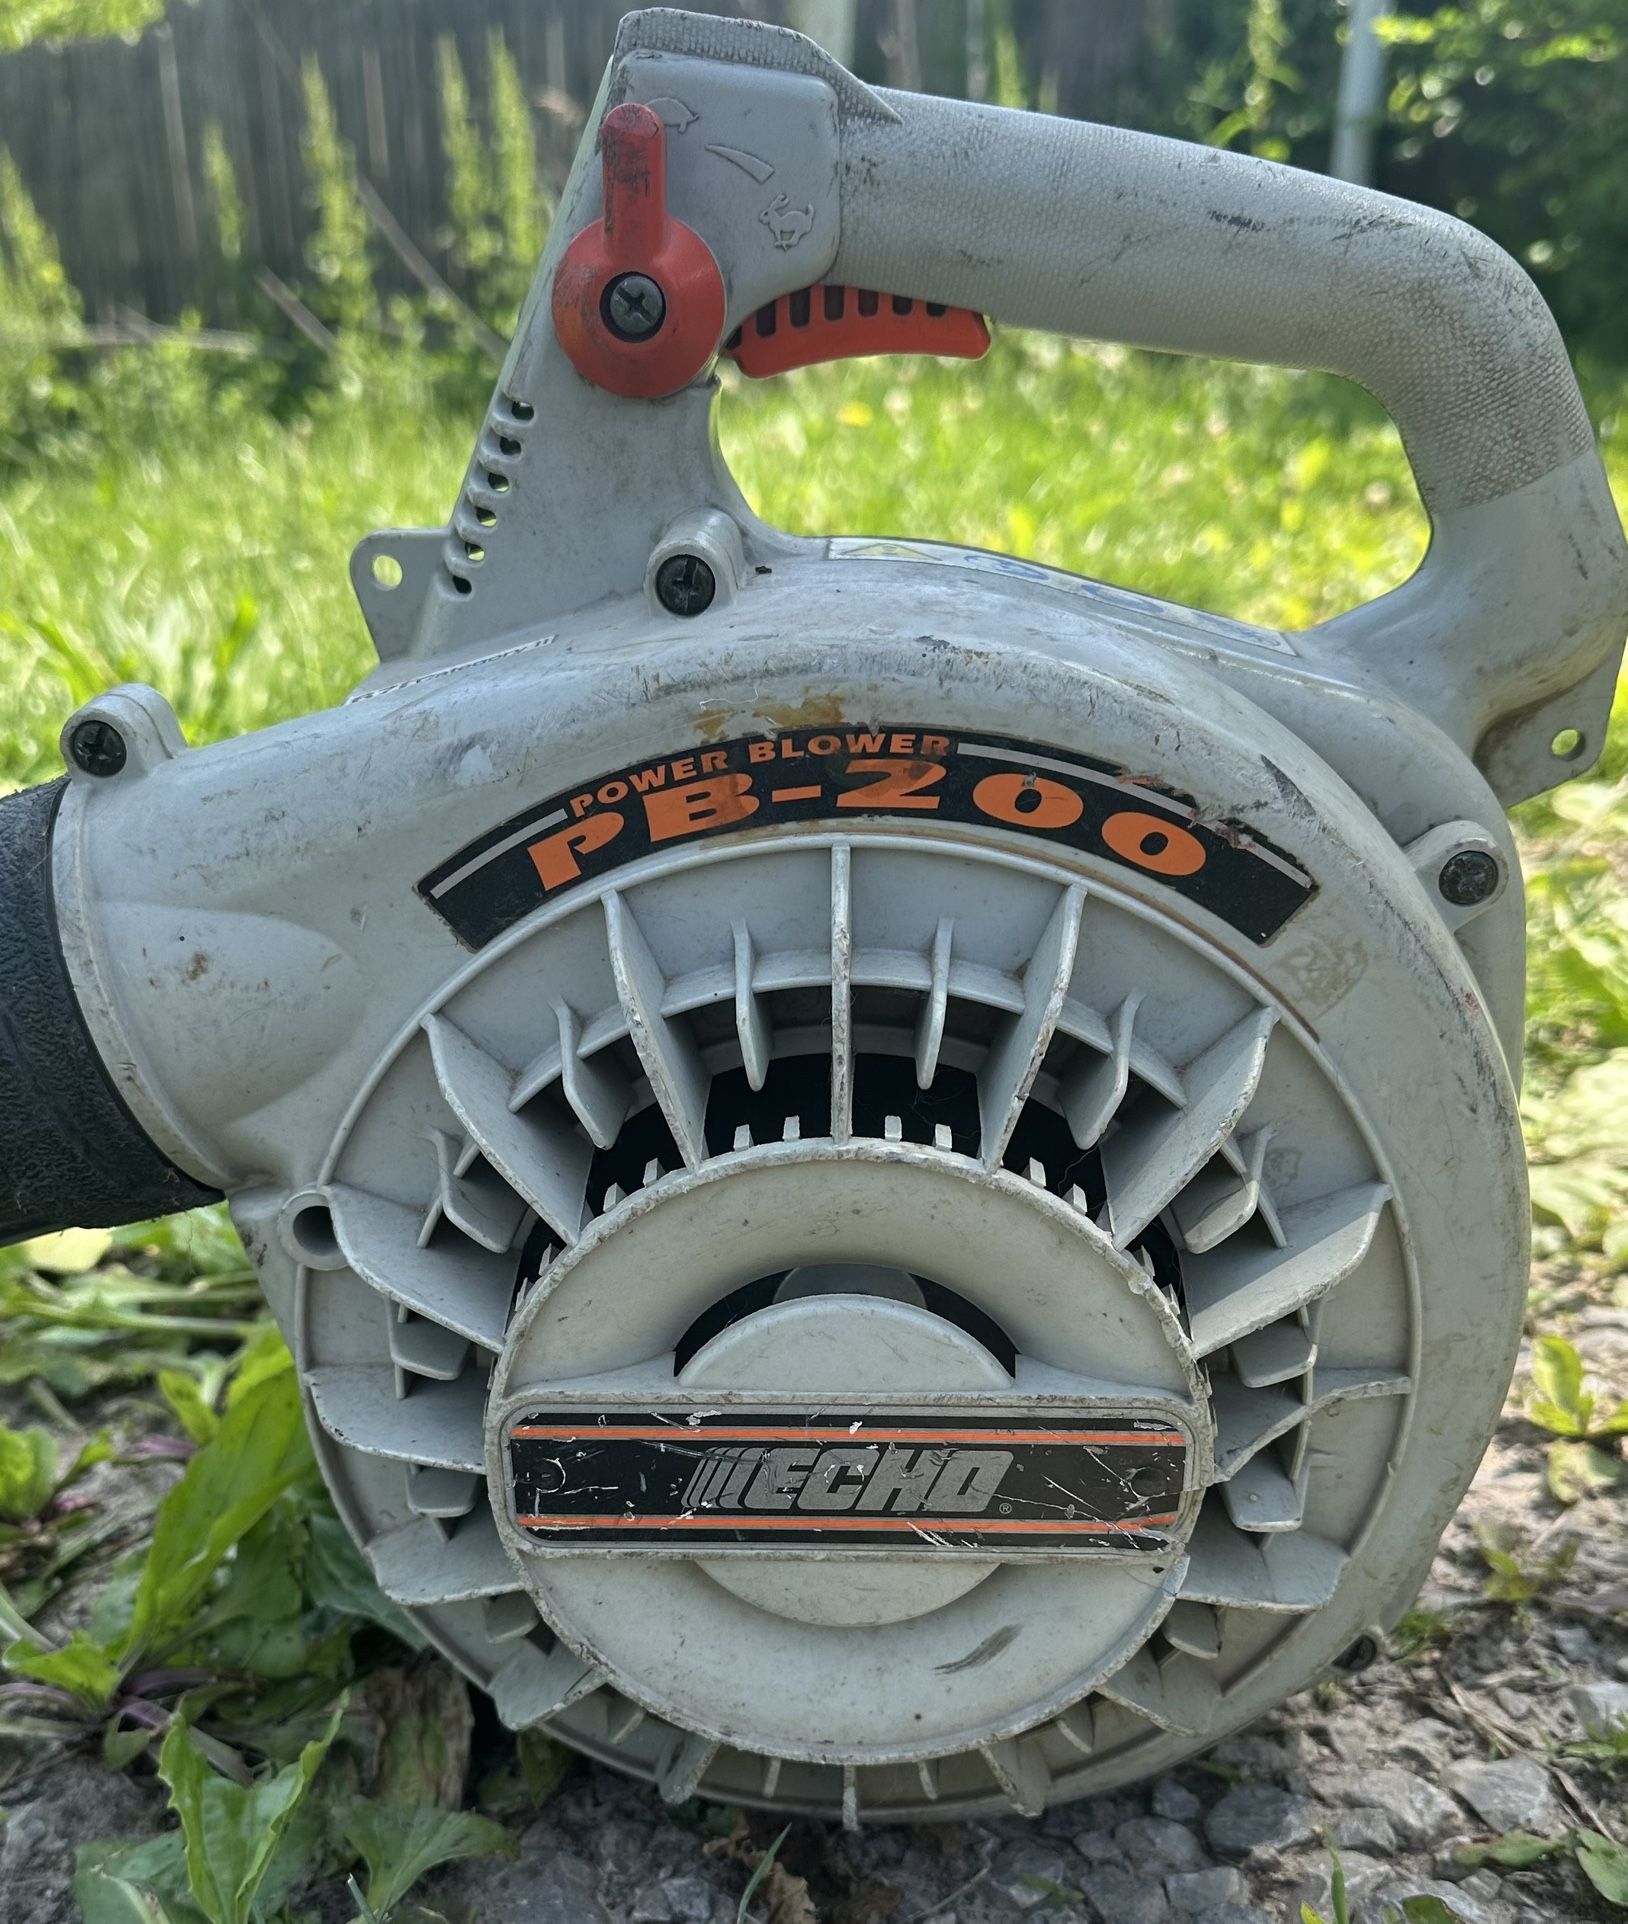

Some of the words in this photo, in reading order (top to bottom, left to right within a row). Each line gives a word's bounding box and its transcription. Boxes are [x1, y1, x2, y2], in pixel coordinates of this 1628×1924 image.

[569, 750, 728, 818] POWER
[748, 734, 950, 763] BLOWER
[528, 758, 1207, 892] PB-200
[743, 1447, 1014, 1512] ECHO
